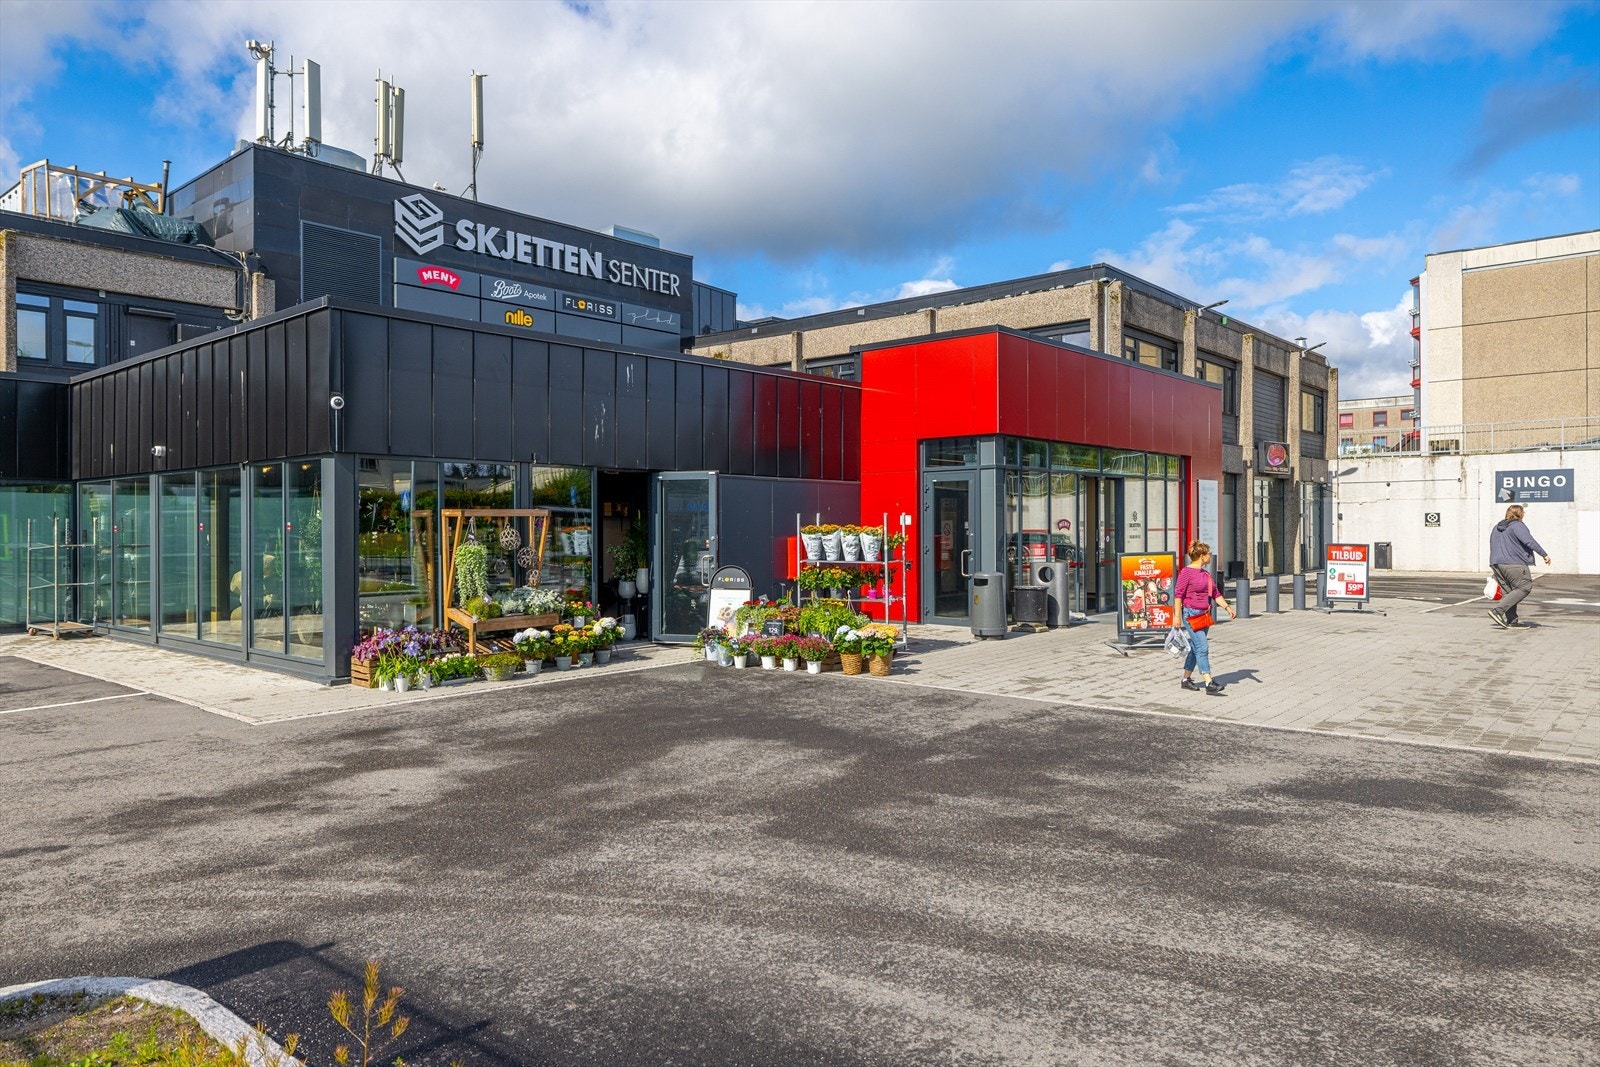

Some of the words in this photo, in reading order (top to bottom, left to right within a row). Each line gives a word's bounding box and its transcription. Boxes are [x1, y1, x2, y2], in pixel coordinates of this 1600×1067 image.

[455, 219, 603, 280] SKJETTEN
[608, 259, 681, 297] SENTER
[421, 270, 457, 285] MENY
[490, 279, 522, 299] Boots
[523, 289, 548, 301] Apotek
[565, 297, 613, 315] FLORISS
[505, 308, 533, 327] nille
[1503, 475, 1567, 488] BINGO
[1331, 550, 1364, 561] TILBUD
